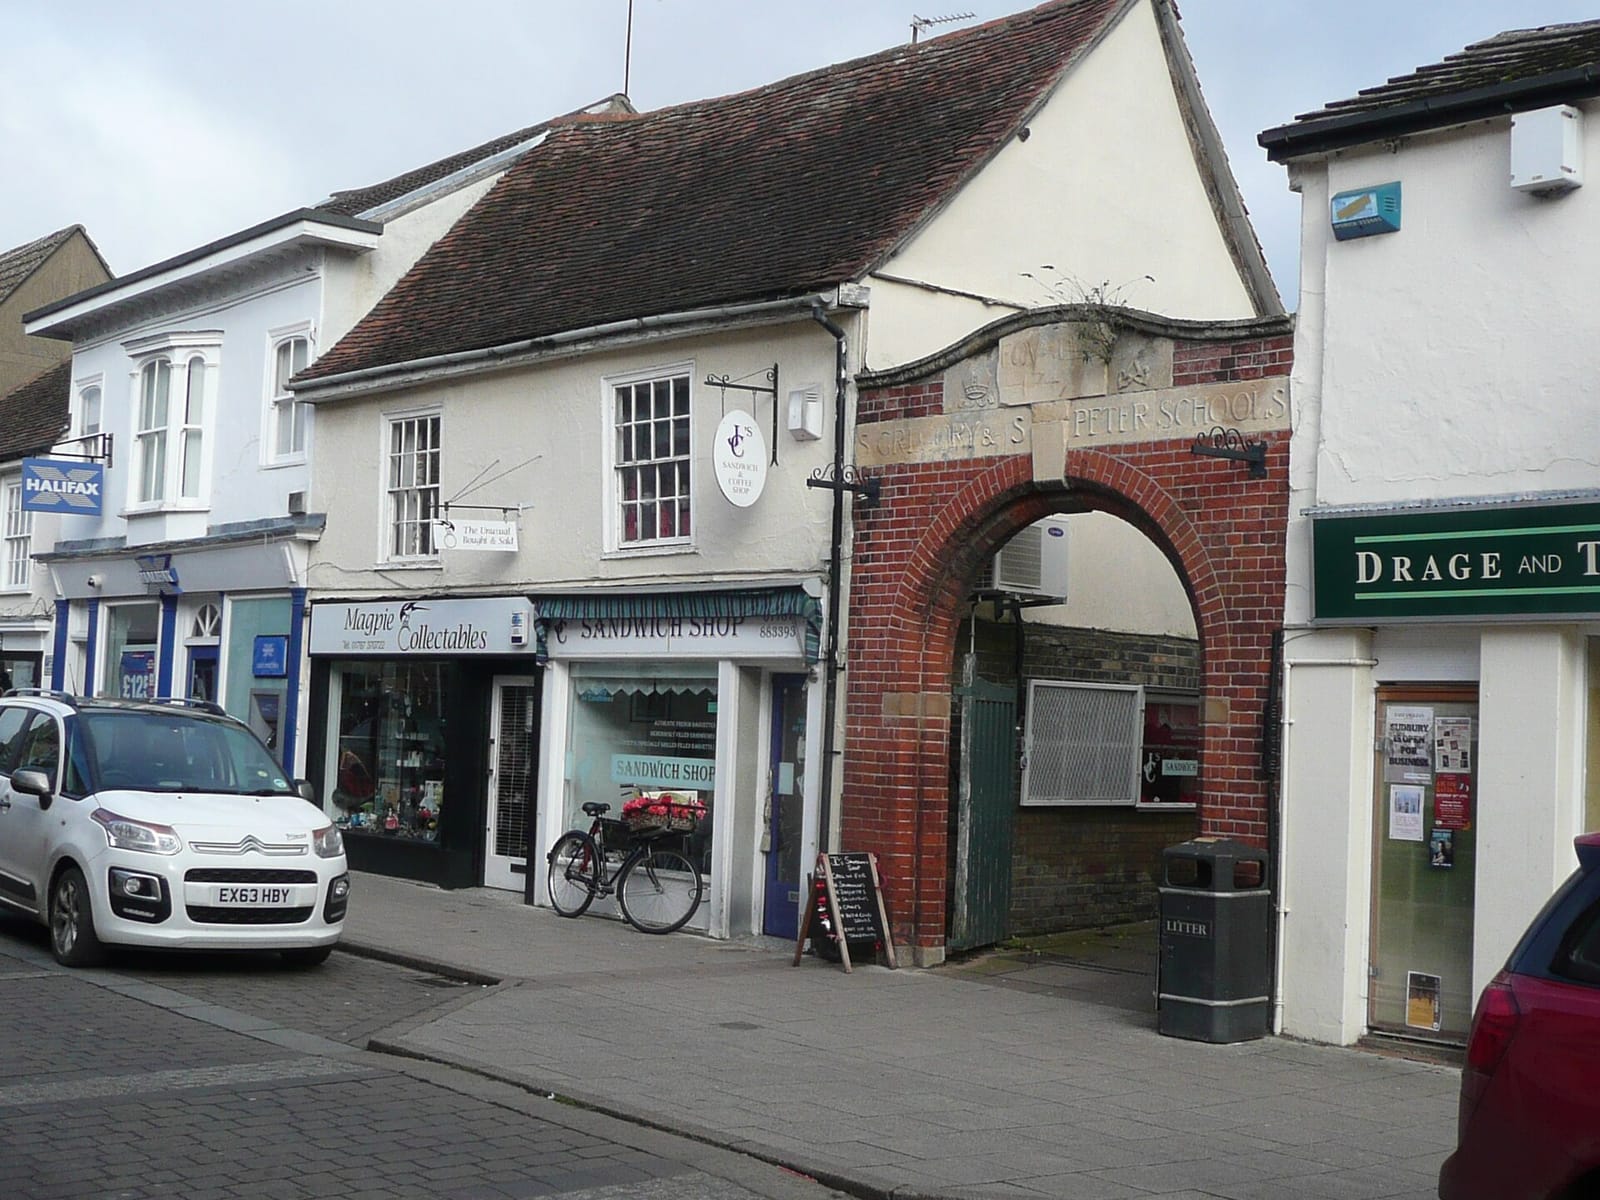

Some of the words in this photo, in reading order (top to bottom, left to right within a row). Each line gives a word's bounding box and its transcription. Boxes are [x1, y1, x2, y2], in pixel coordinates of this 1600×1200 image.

[1073, 401, 1149, 438] PETER
[1156, 388, 1286, 429] SCHOOLS
[722, 461, 758, 472] SANDWICH
[26, 477, 99, 496] HALIFAX
[732, 486, 750, 495] SHOP
[463, 525, 478, 535] The
[462, 535, 487, 546] Bought
[498, 535, 514, 546] Sold
[1518, 554, 1562, 574] AND
[344, 608, 395, 636] Magpie
[581, 617, 683, 639] SANDWICH
[689, 615, 744, 637] SHOP
[398, 624, 487, 652] Collectables
[1390, 723, 1429, 733] SUDBURY
[1402, 735, 1425, 743] OPEN
[1389, 757, 1429, 767] BUSINESS
[616, 759, 681, 780] SANDWICH
[682, 764, 716, 782] SHOP
[219, 888, 258, 903] EX63
[261, 889, 290, 903] HBY
[1166, 919, 1207, 936] LITTER
